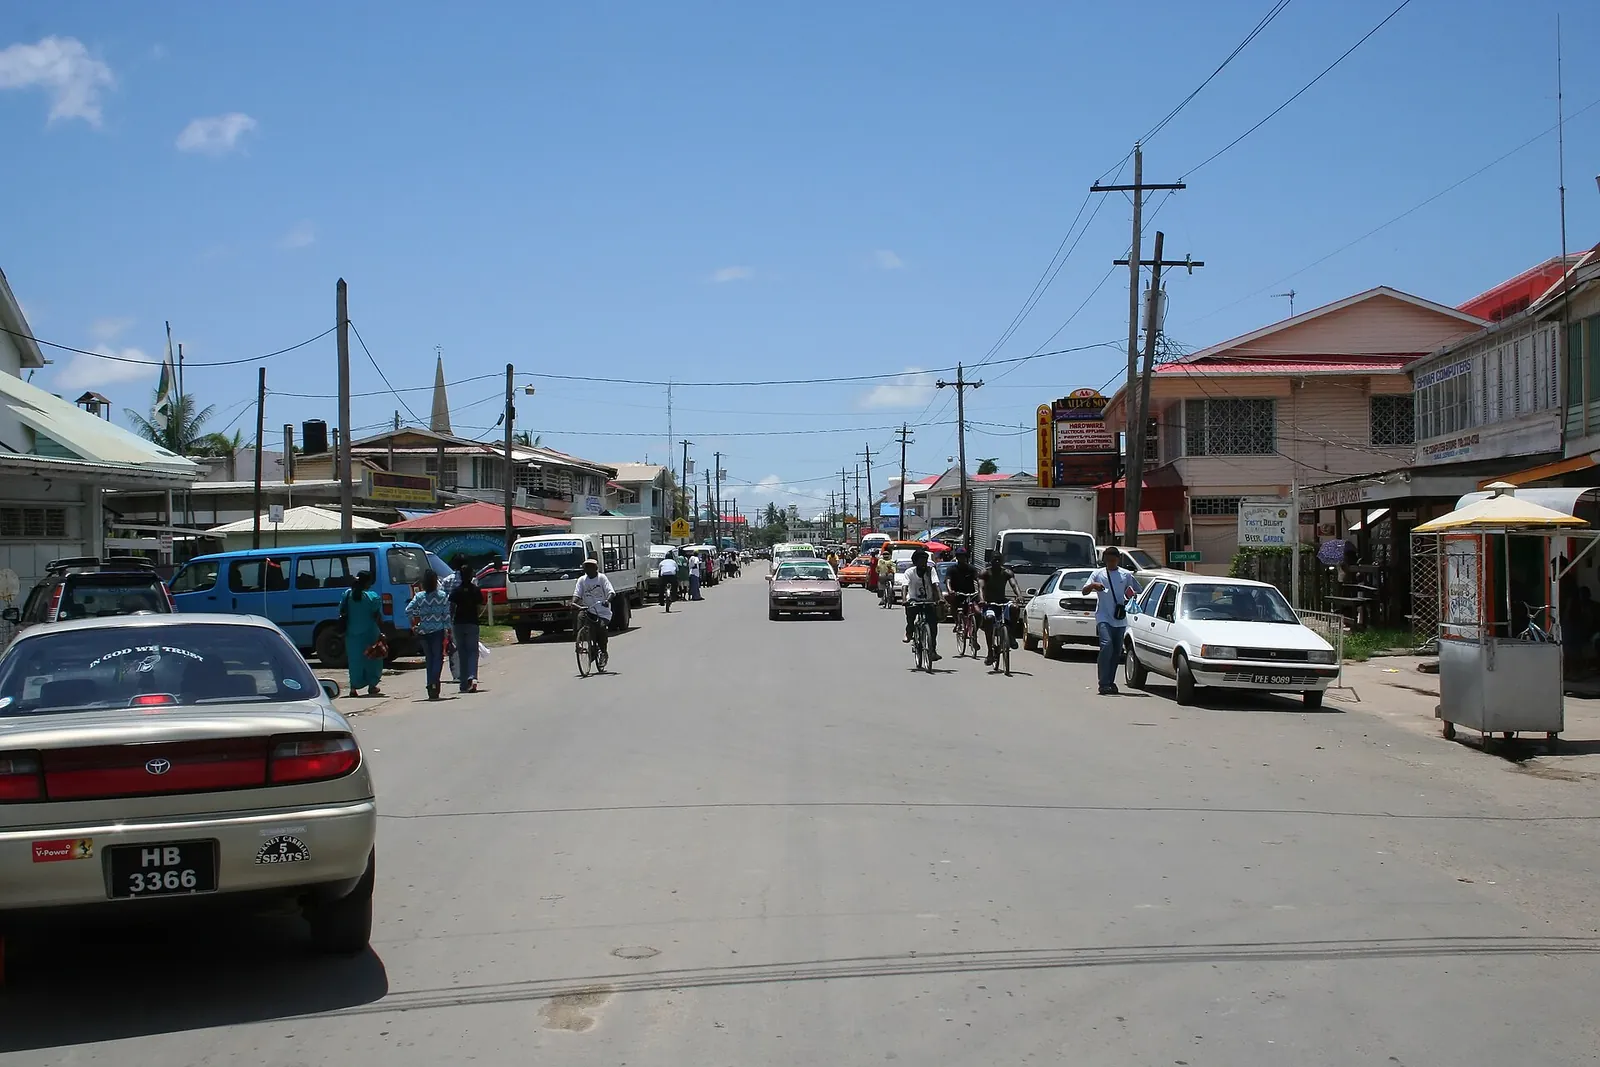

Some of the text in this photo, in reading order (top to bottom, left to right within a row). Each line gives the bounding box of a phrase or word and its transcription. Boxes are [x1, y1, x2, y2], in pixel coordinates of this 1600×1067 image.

[1436, 359, 1471, 381] COMPUTERS
[1244, 534, 1262, 542] BEER
[89, 658, 100, 669] IN
[102, 648, 132, 661] GOD
[162, 646, 204, 662] TRUST
[36, 849, 69, 857] V-Power
[141, 847, 182, 868] HB
[255, 836, 310, 864] HACKNEY CARRIAGE
[262, 852, 303, 864] SEATS
[279, 843, 288, 854] 5
[129, 869, 197, 893] 3366
